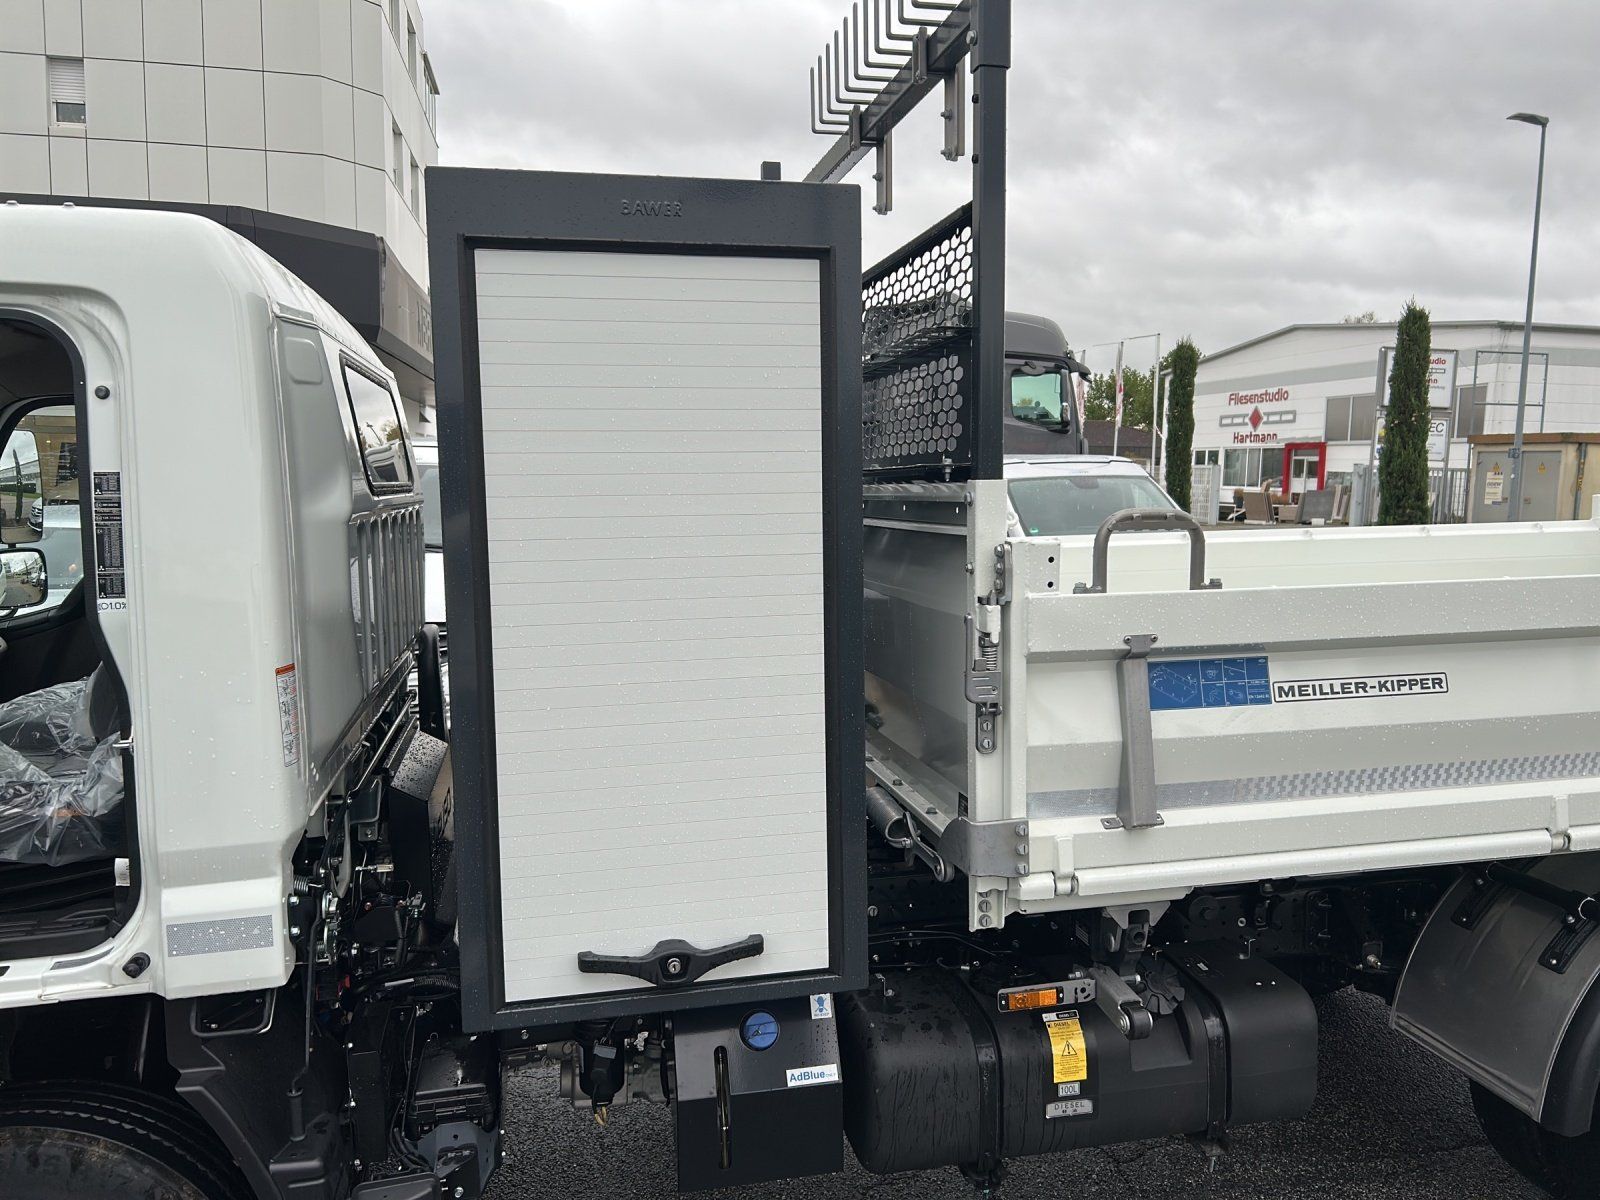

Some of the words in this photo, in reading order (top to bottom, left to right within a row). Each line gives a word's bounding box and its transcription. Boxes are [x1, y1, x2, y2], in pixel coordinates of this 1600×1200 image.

[620, 199, 682, 217] BAWER
[1228, 388, 1289, 406] Fliesenstudio
[1232, 431, 1278, 445] Hartmann
[1277, 677, 1444, 699] MEILLER-KIPPER
[789, 1070, 826, 1083] AdBlue
[1060, 1084, 1078, 1095] 100L
[1054, 1101, 1085, 1111] DIESEL
